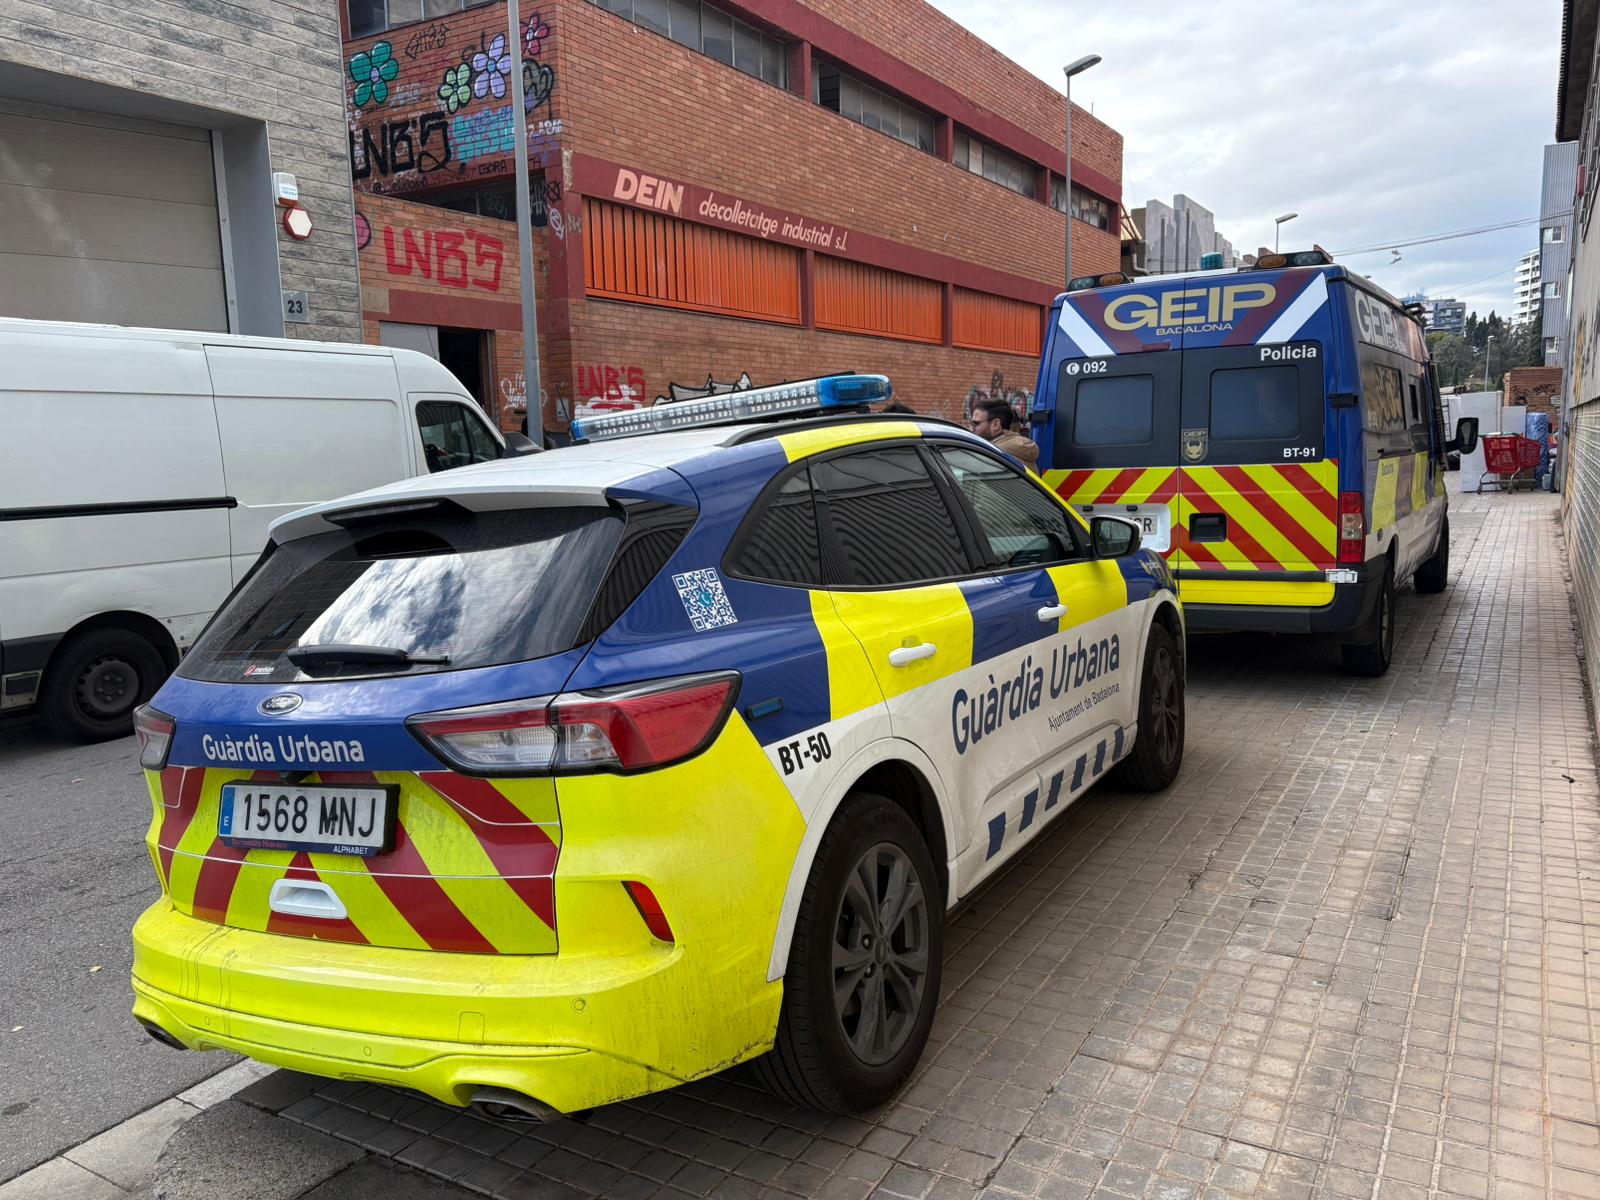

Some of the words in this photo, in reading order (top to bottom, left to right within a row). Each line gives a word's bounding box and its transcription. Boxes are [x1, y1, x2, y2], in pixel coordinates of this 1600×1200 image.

[613, 168, 684, 213] DEIN
[699, 192, 778, 237] decolletatge
[782, 216, 833, 247] industrial
[835, 231, 847, 251] s.l.
[287, 300, 303, 314] 23
[1103, 282, 1277, 331] GEIP
[1155, 323, 1233, 336] BADALONA
[1083, 361, 1108, 374] 092
[1283, 447, 1316, 458] BT-91
[952, 655, 1044, 756] Guàrdia
[1050, 633, 1120, 700] Urbana
[1048, 702, 1085, 732] Ajuntament
[1084, 695, 1093, 712] de
[1092, 682, 1120, 706] Badalona
[202, 733, 276, 762] Guàrdia
[278, 734, 365, 763] Urbana
[777, 731, 832, 776] BT-50
[223, 815, 229, 827] E
[244, 793, 309, 834] 1568
[318, 796, 376, 838] MNJ
[333, 845, 369, 855] ALPHABET
